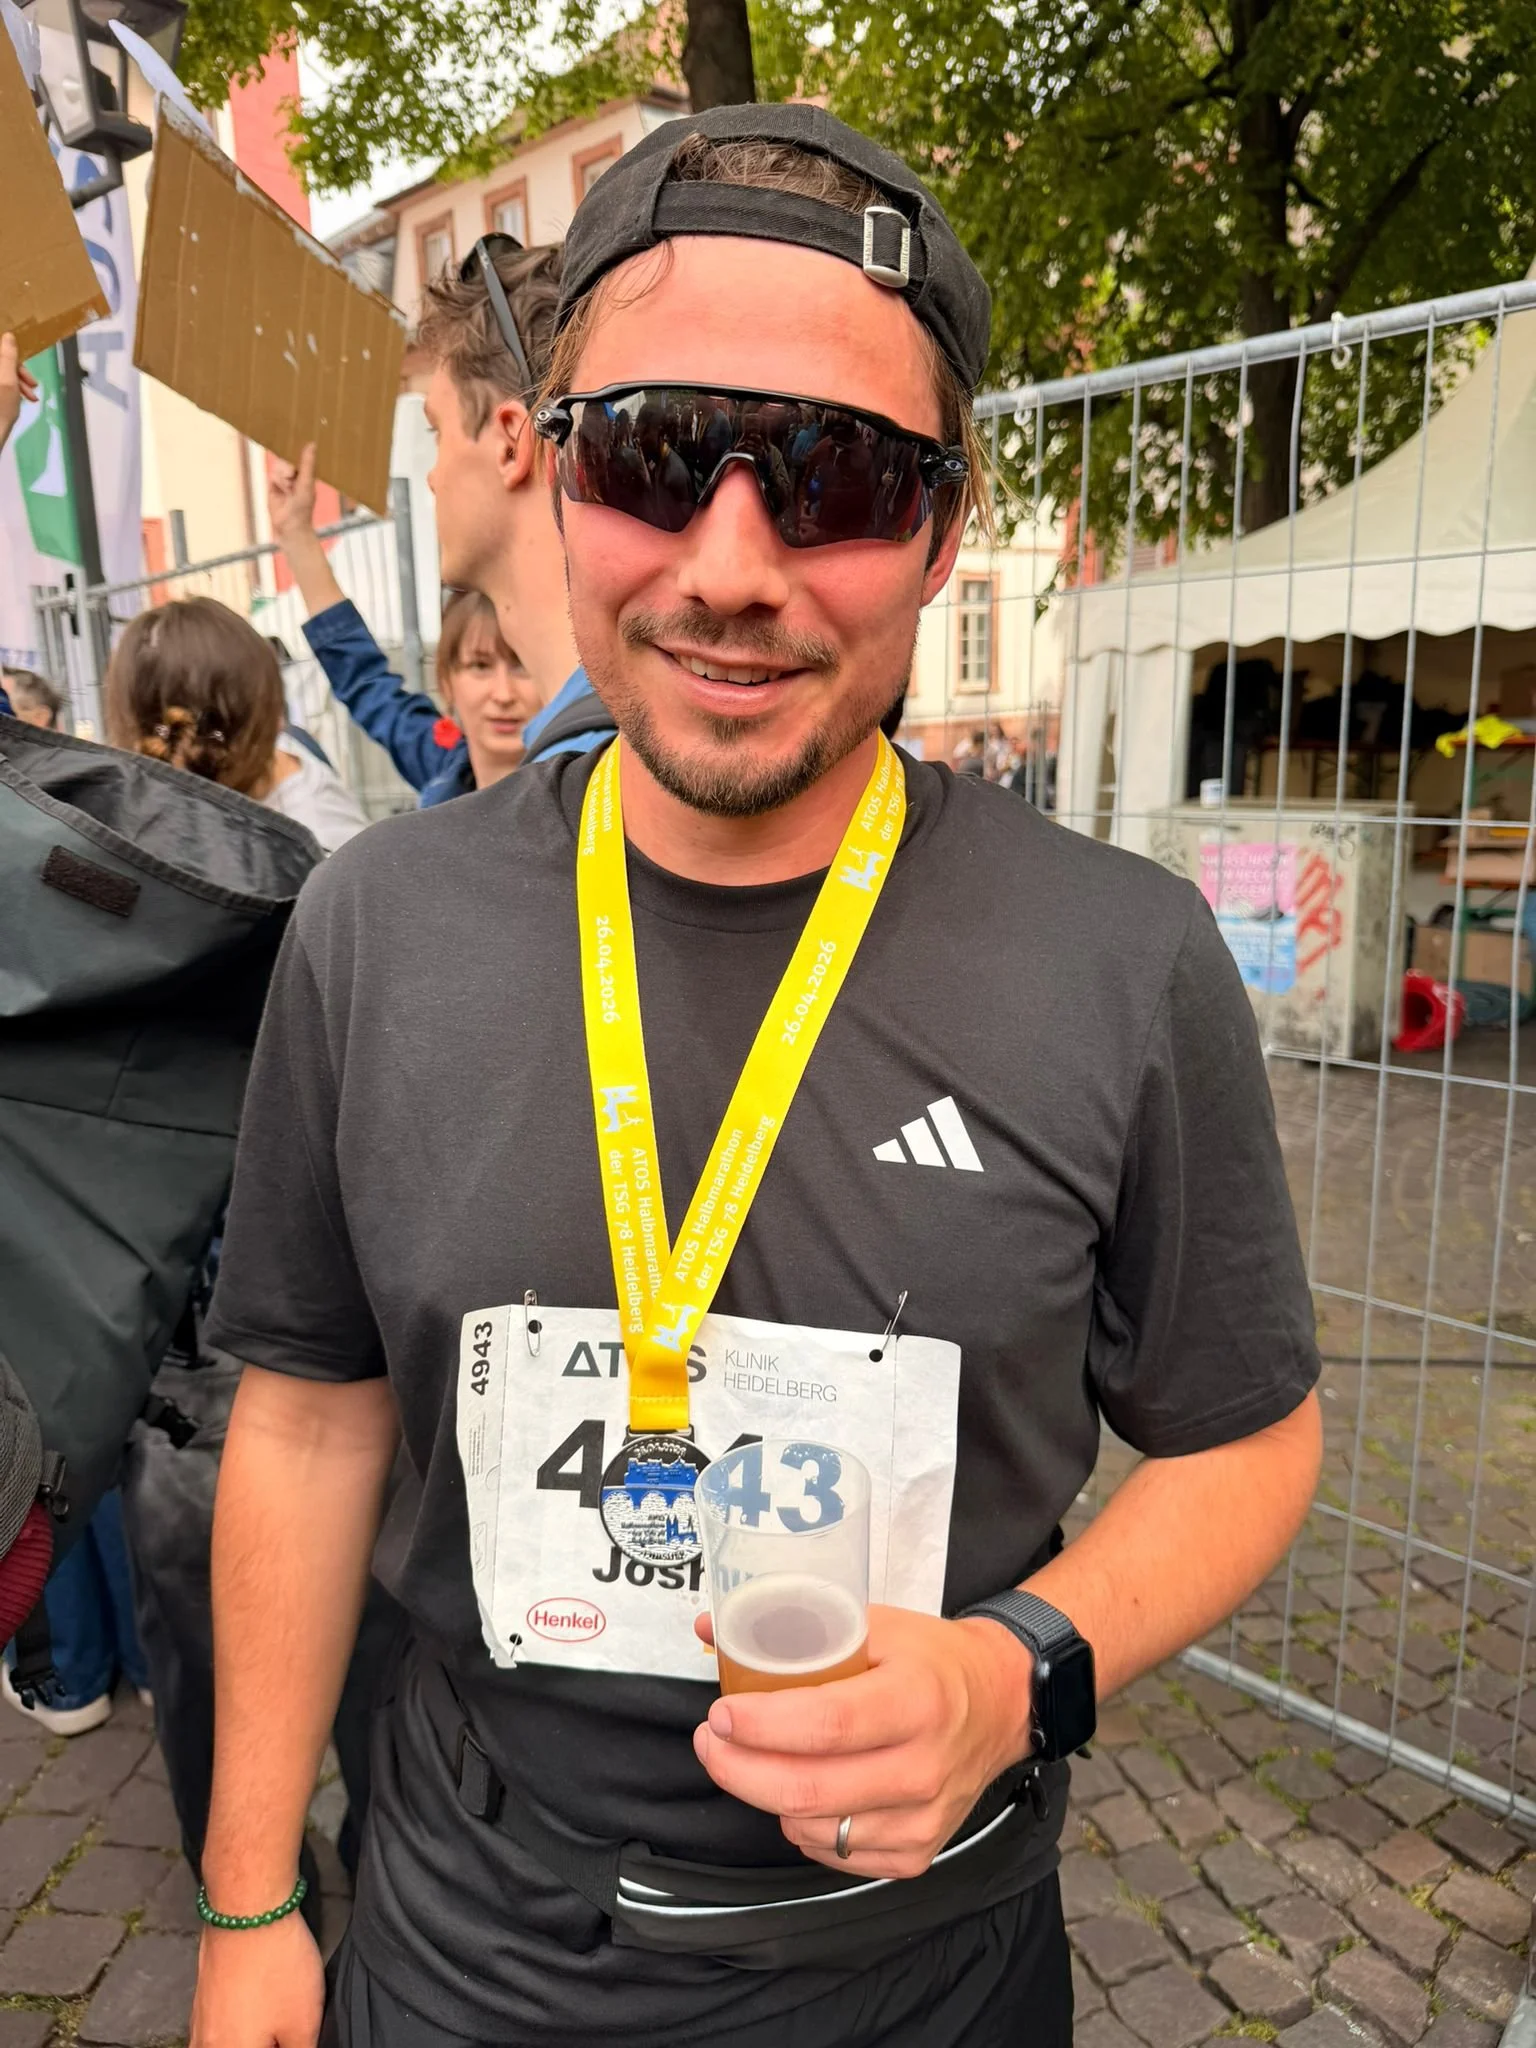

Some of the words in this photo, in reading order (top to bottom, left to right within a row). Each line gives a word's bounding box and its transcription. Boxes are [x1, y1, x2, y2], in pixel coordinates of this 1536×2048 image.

[583, 787, 599, 855] Heidelberg
[860, 794, 882, 832] ATOS
[886, 792, 901, 816] TSG
[880, 818, 894, 841] der
[596, 915, 621, 1024] 26.04.2026
[781, 939, 836, 1045] 26.04.2026
[609, 1149, 624, 1176] der
[633, 1147, 650, 1191] ATOS
[730, 1115, 776, 1198] Heidelberg
[614, 1181, 630, 1213] TSG
[674, 1239, 700, 1283] ATOS
[692, 1128, 744, 1235] Halbmarathon
[724, 1202, 739, 1224] 78
[615, 1220, 634, 1240] 78
[638, 1196, 663, 1298] Halbmaratho
[705, 1227, 728, 1258] TSG
[620, 1245, 644, 1334] Heidelberg
[695, 1264, 714, 1290] der
[471, 1321, 492, 1396] 4943
[561, 1341, 707, 1383] ATS
[725, 1348, 780, 1373] KLINIK
[723, 1372, 837, 1402] HEIDELBERG
[536, 1419, 845, 1533] 443
[534, 1609, 599, 1630] Henkel
